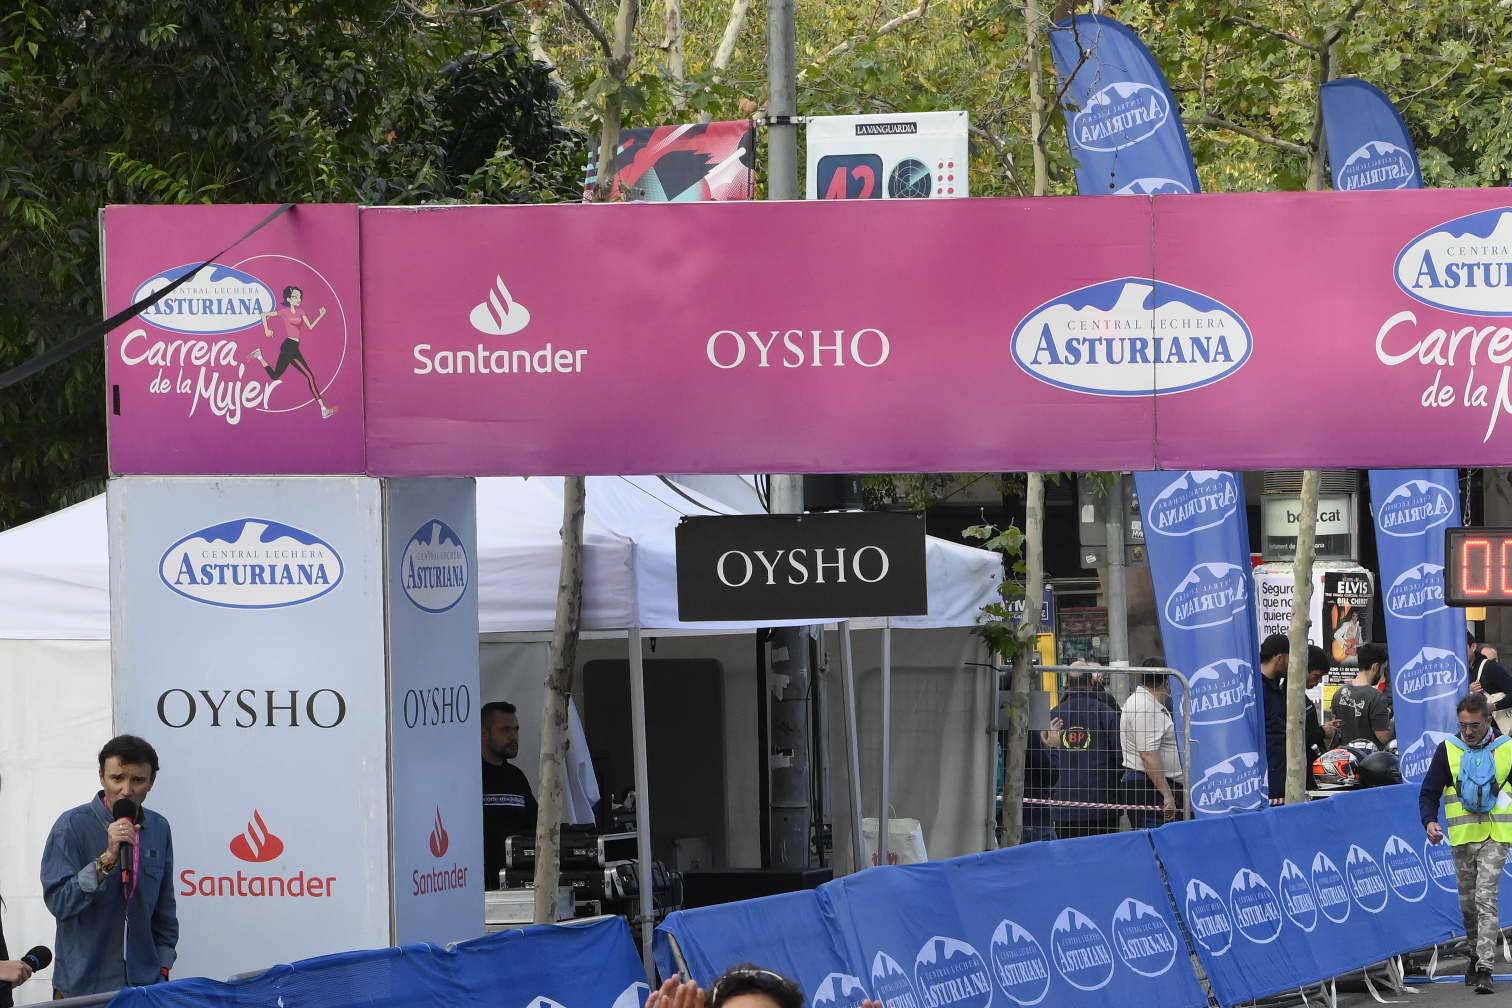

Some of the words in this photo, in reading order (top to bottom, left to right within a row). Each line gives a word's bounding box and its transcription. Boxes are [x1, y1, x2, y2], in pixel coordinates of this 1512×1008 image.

[143, 288, 264, 316] ASTURIANA
[172, 286, 210, 295] ENTRAL
[1066, 318, 1143, 330] CENTRAL
[1149, 317, 1226, 330] LECHERA
[120, 329, 238, 367] Carrera
[413, 342, 589, 375] Santander
[706, 328, 891, 369] OYSHO
[1029, 322, 1234, 366] ASTURIANA
[149, 369, 174, 394] de
[176, 367, 192, 395] la
[189, 361, 283, 426] Mujer
[1421, 369, 1456, 410] de
[1463, 367, 1490, 409] la
[173, 551, 330, 586] ASTURIANA
[201, 549, 259, 559] CENTRAL
[265, 548, 324, 559] LECHERA
[716, 545, 890, 588] OYSHO
[406, 554, 465, 590] ASTURIANA
[1337, 581, 1369, 594] ELVIS
[1262, 597, 1280, 608] que
[1263, 610, 1296, 622] quiere
[156, 688, 347, 729] OYSHO
[403, 683, 470, 729] OYSHO
[180, 868, 337, 898] Santander
[412, 863, 468, 896] Santander
[1056, 940, 1112, 974] ASTURIANA
